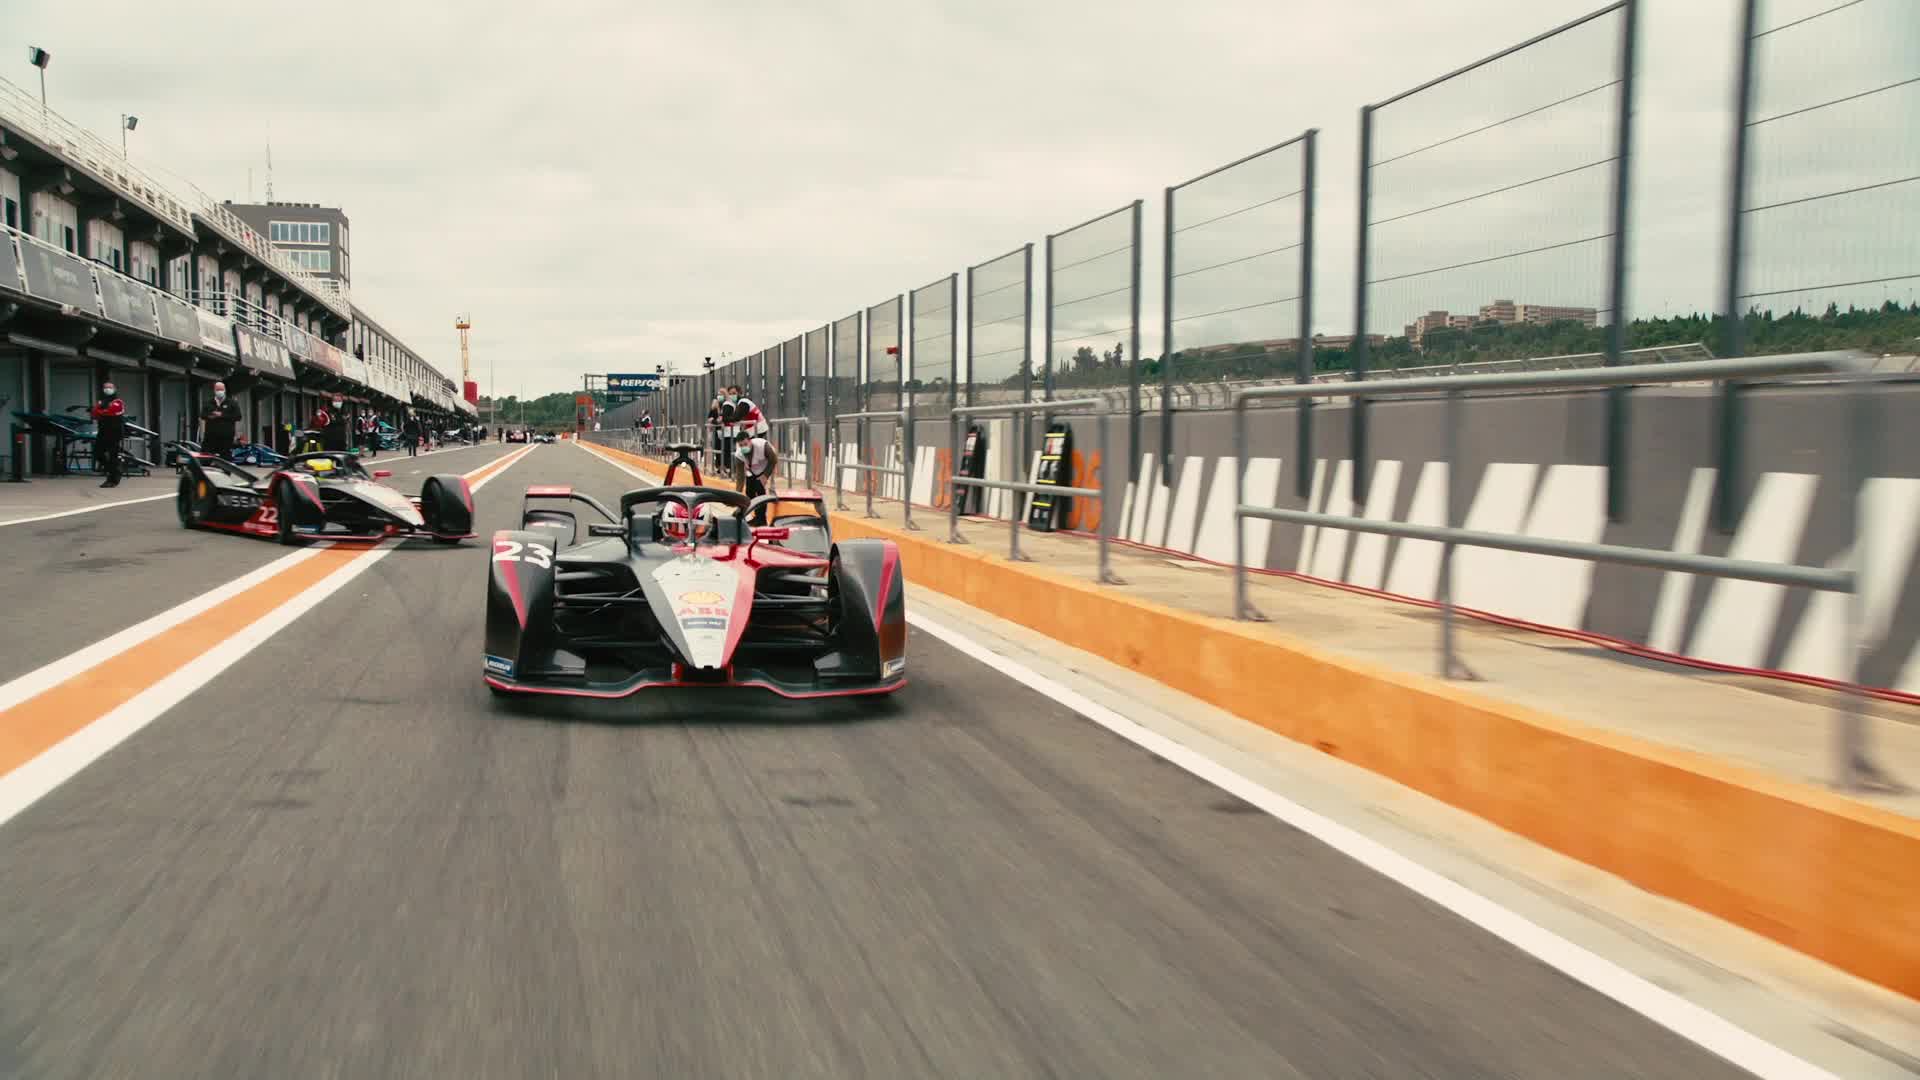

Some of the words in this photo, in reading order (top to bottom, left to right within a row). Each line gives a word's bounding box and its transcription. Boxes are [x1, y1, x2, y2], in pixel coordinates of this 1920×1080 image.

[620, 379, 661, 388] REPSO
[258, 506, 278, 523] 22
[493, 540, 553, 569] 23
